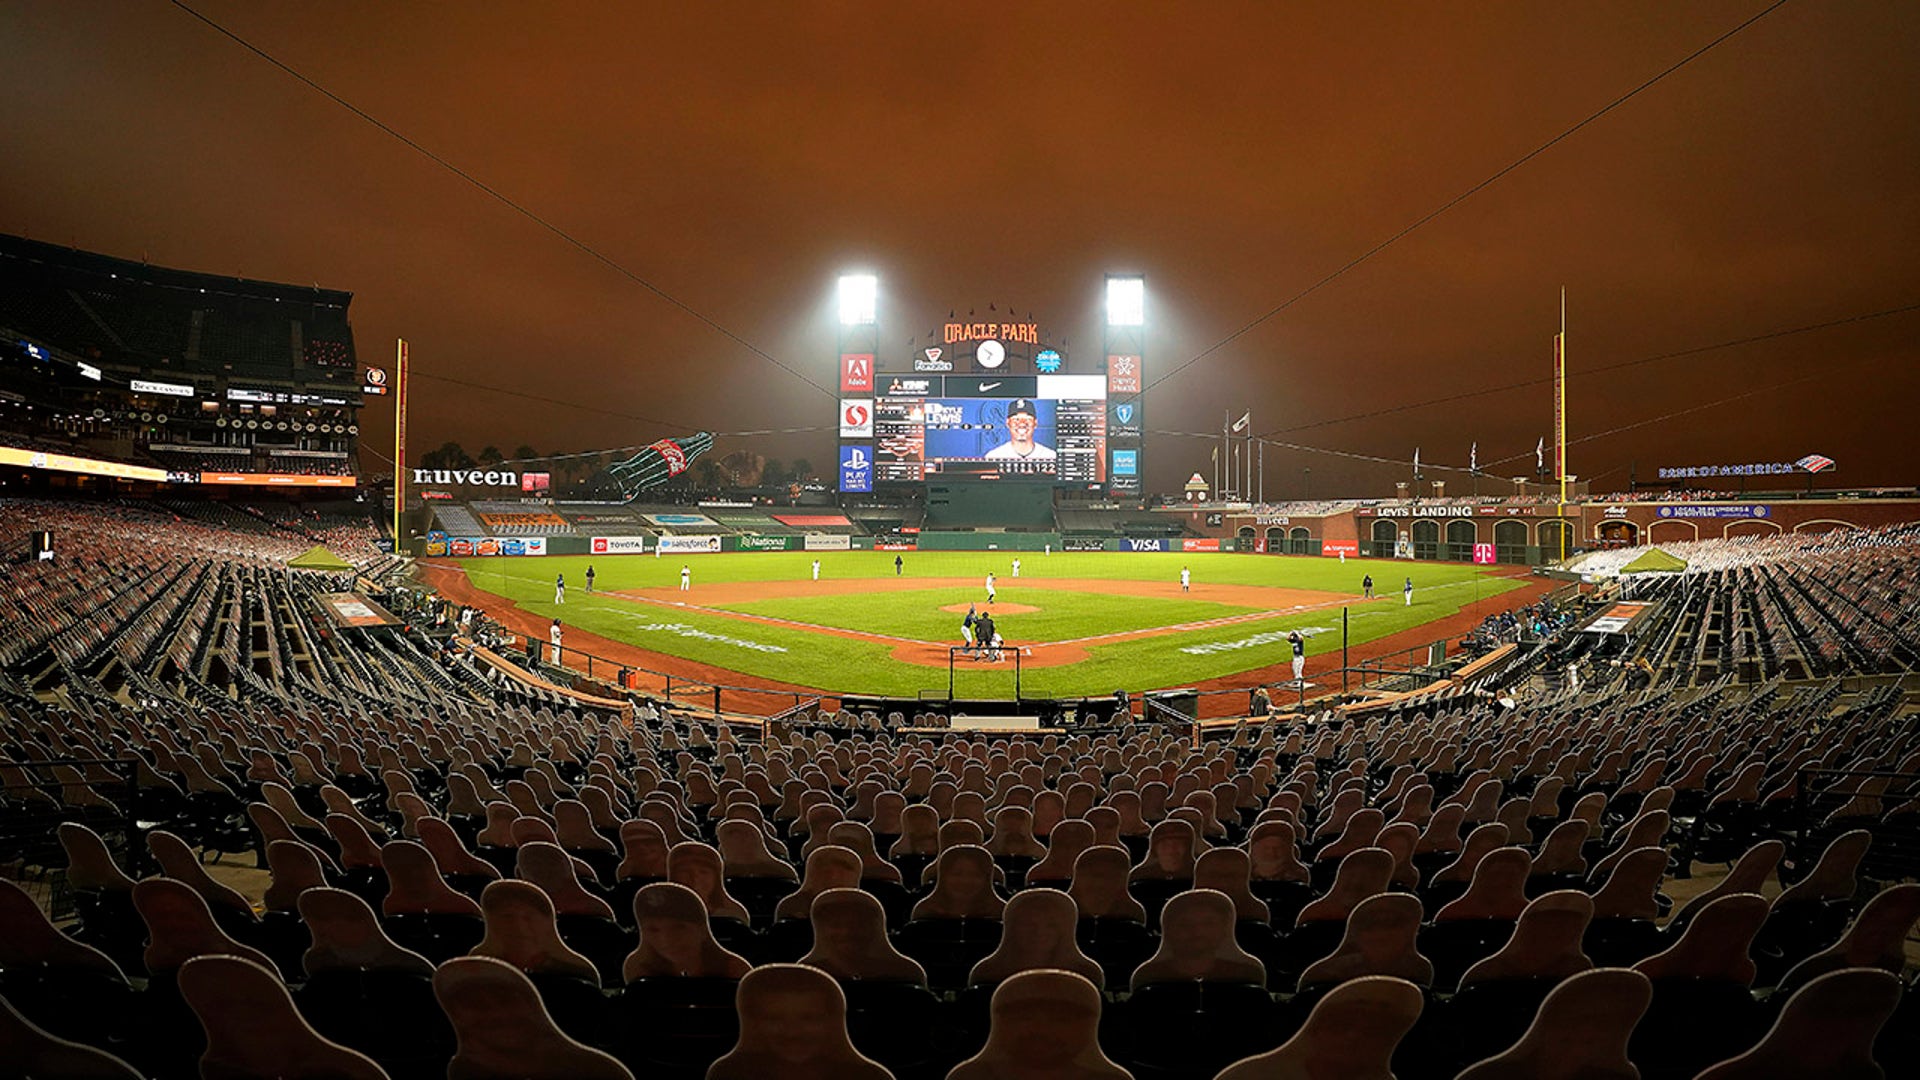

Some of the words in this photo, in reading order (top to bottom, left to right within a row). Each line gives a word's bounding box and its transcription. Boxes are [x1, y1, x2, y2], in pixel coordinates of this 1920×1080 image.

[944, 323, 997, 344] ORACLE
[1001, 324, 1038, 344] PARK
[848, 378, 867, 386] Adobe
[1701, 465, 1718, 476] OF
[1722, 463, 1793, 475] AMERICA
[413, 469, 517, 486] nuveen
[845, 471, 866, 479] PLAY
[1412, 507, 1473, 517] LANDING
[1256, 517, 1290, 525] nuveen
[672, 539, 708, 549] salesforce
[751, 537, 787, 546] National
[1128, 539, 1160, 551] VISA
